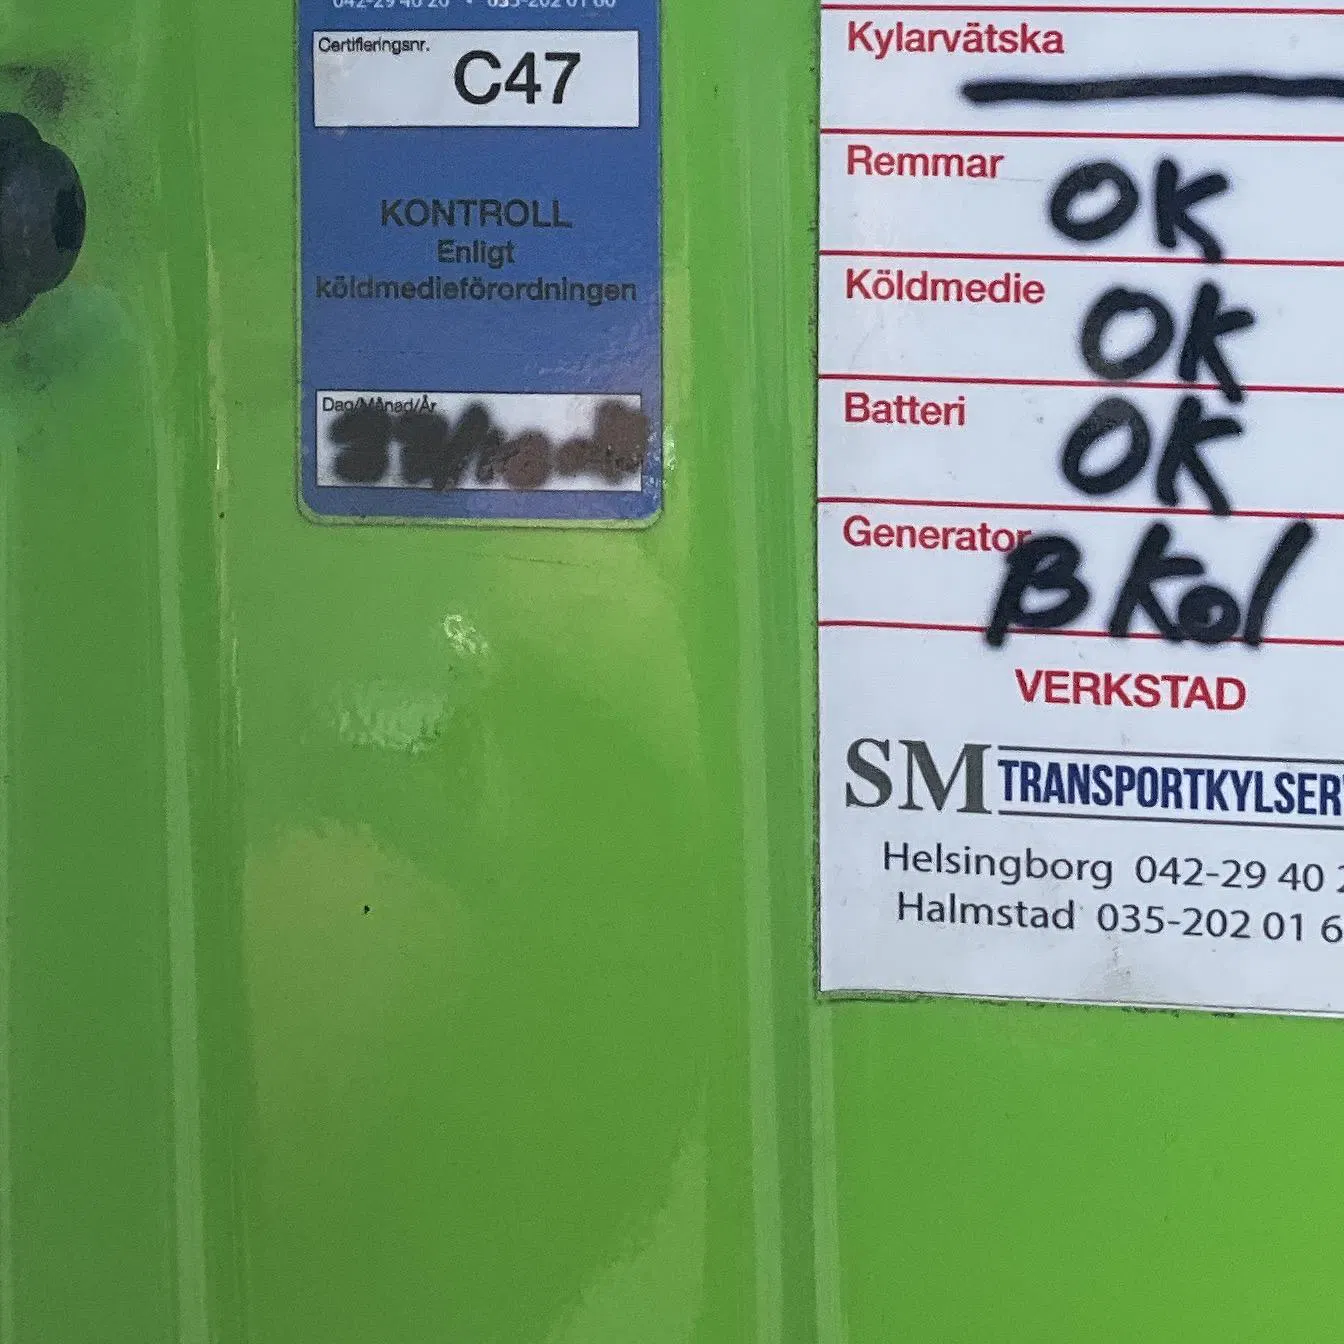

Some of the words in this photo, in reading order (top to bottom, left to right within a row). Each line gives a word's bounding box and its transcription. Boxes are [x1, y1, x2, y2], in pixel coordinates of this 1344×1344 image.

[318, 37, 431, 55] Certifieringsnr.
[847, 20, 1066, 60] Kylarvätska
[455, 49, 581, 105] C47
[846, 145, 1005, 180] Remmar
[381, 199, 573, 228] KONTROLL
[1049, 157, 1229, 264] OK
[437, 239, 516, 268] Enligt
[315, 275, 637, 306] köldmedieförordningen
[845, 269, 1045, 305] Köldmedie
[1081, 282, 1256, 403] OK
[844, 393, 966, 426] Batteri
[1061, 395, 1243, 517] OK
[842, 515, 1031, 555] Generator
[1016, 669, 1247, 711] VERKSTAD
[845, 737, 992, 815] SM
[882, 840, 1114, 889] Helsingborg
[1135, 854, 1267, 891] 042-29
[1278, 862, 1325, 893] 40
[897, 891, 1076, 931] Halmstad
[1097, 903, 1252, 940] 035-202
[1263, 912, 1306, 942] 01
